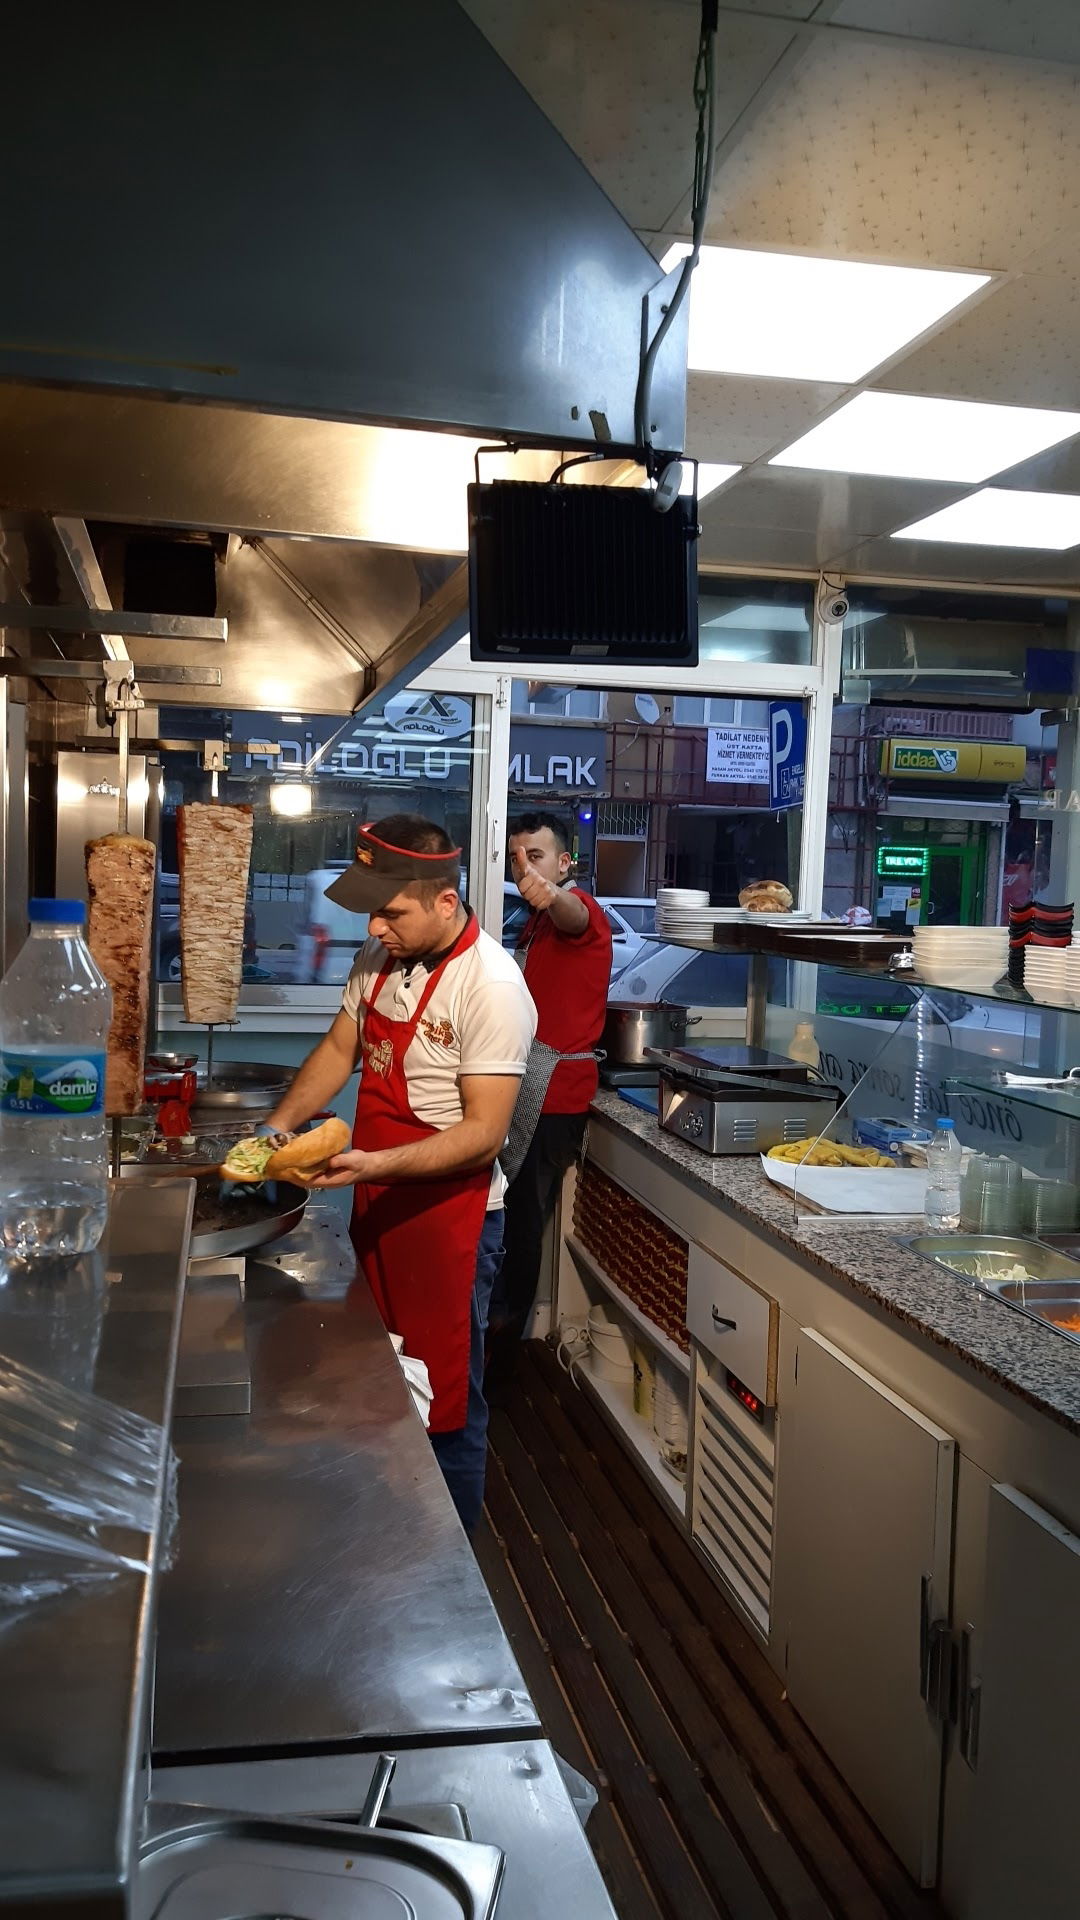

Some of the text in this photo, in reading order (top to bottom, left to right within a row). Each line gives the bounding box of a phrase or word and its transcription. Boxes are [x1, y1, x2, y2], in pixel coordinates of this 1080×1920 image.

[716, 732, 742, 741] TADİLAT
[245, 732, 451, 779] ADİLOĞLU
[717, 748, 735, 758] HİZMET
[772, 708, 793, 798] P
[897, 751, 937, 768] iddaa
[49, 1080, 97, 1096] damla
